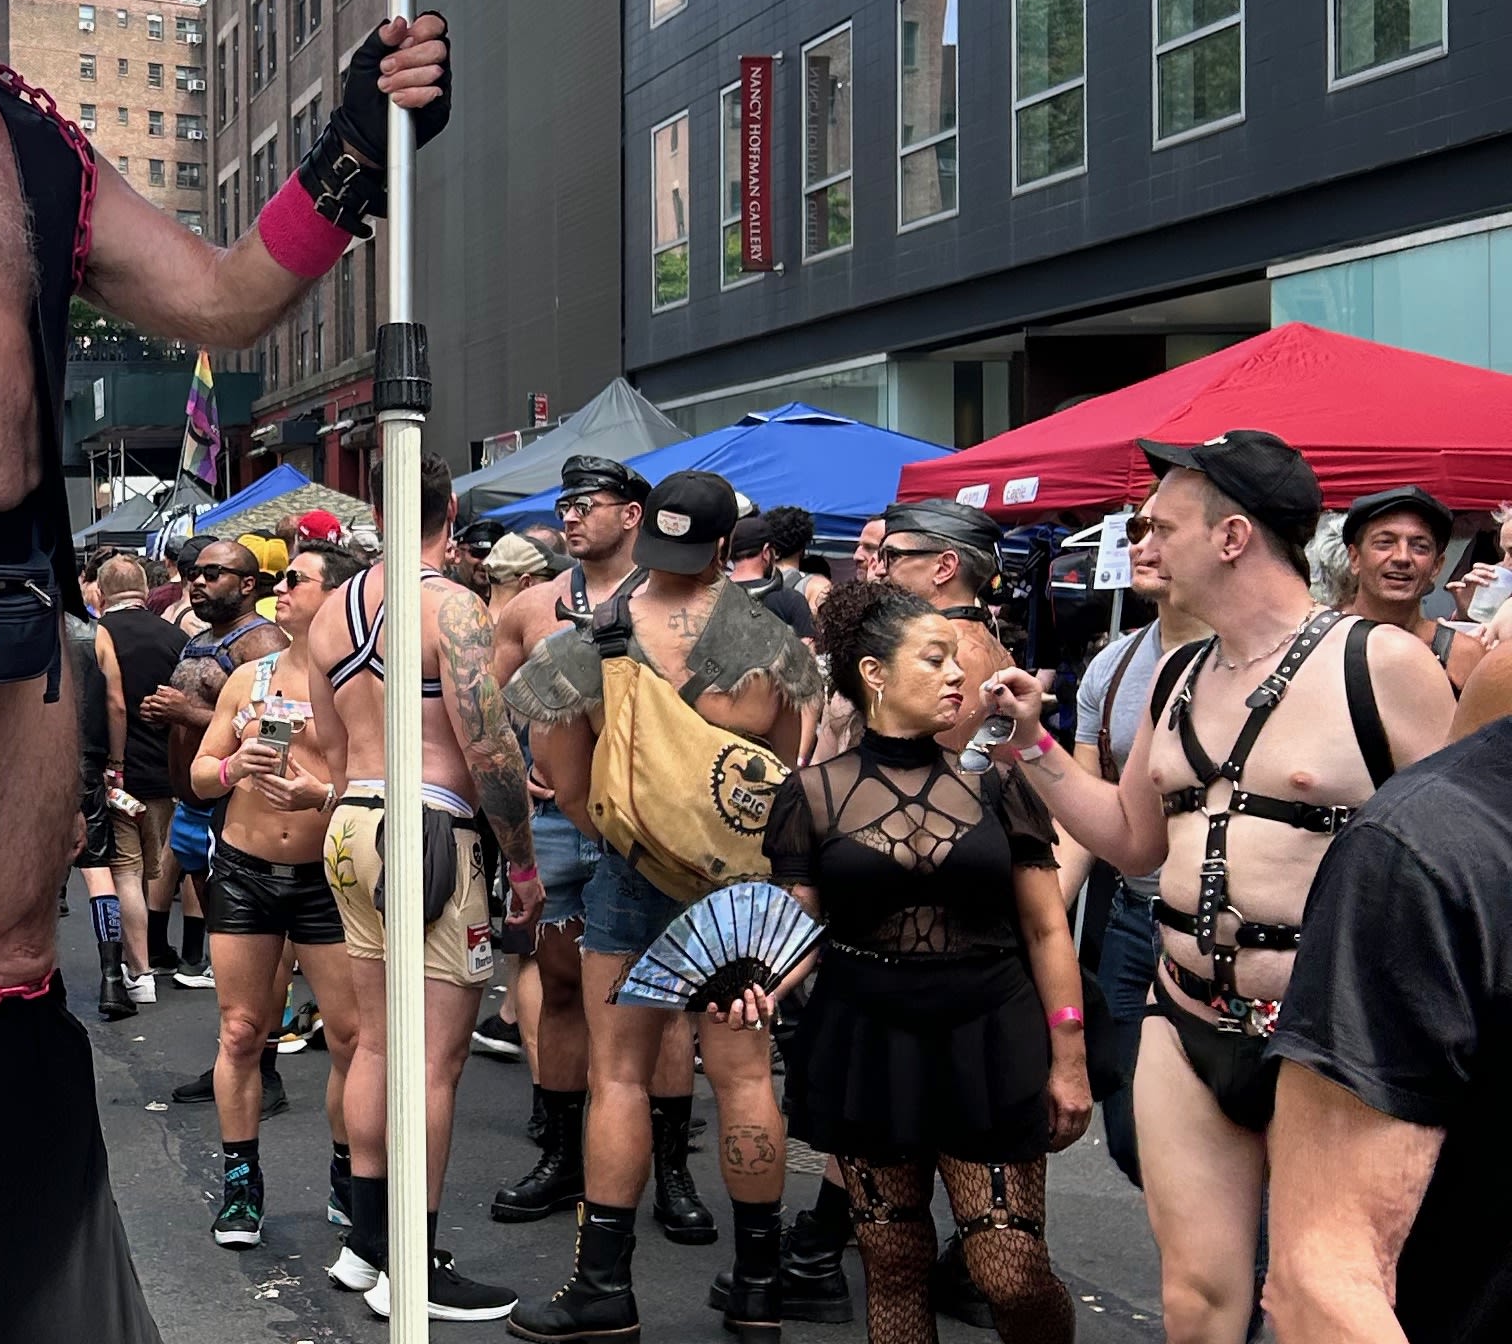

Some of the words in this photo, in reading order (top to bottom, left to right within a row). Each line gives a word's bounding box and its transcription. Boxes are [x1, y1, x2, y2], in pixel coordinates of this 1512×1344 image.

[750, 66, 762, 120] NANCY
[749, 124, 761, 197] HOFFMAN
[749, 201, 763, 262] GALLERY
[731, 786, 766, 816] EPIC
